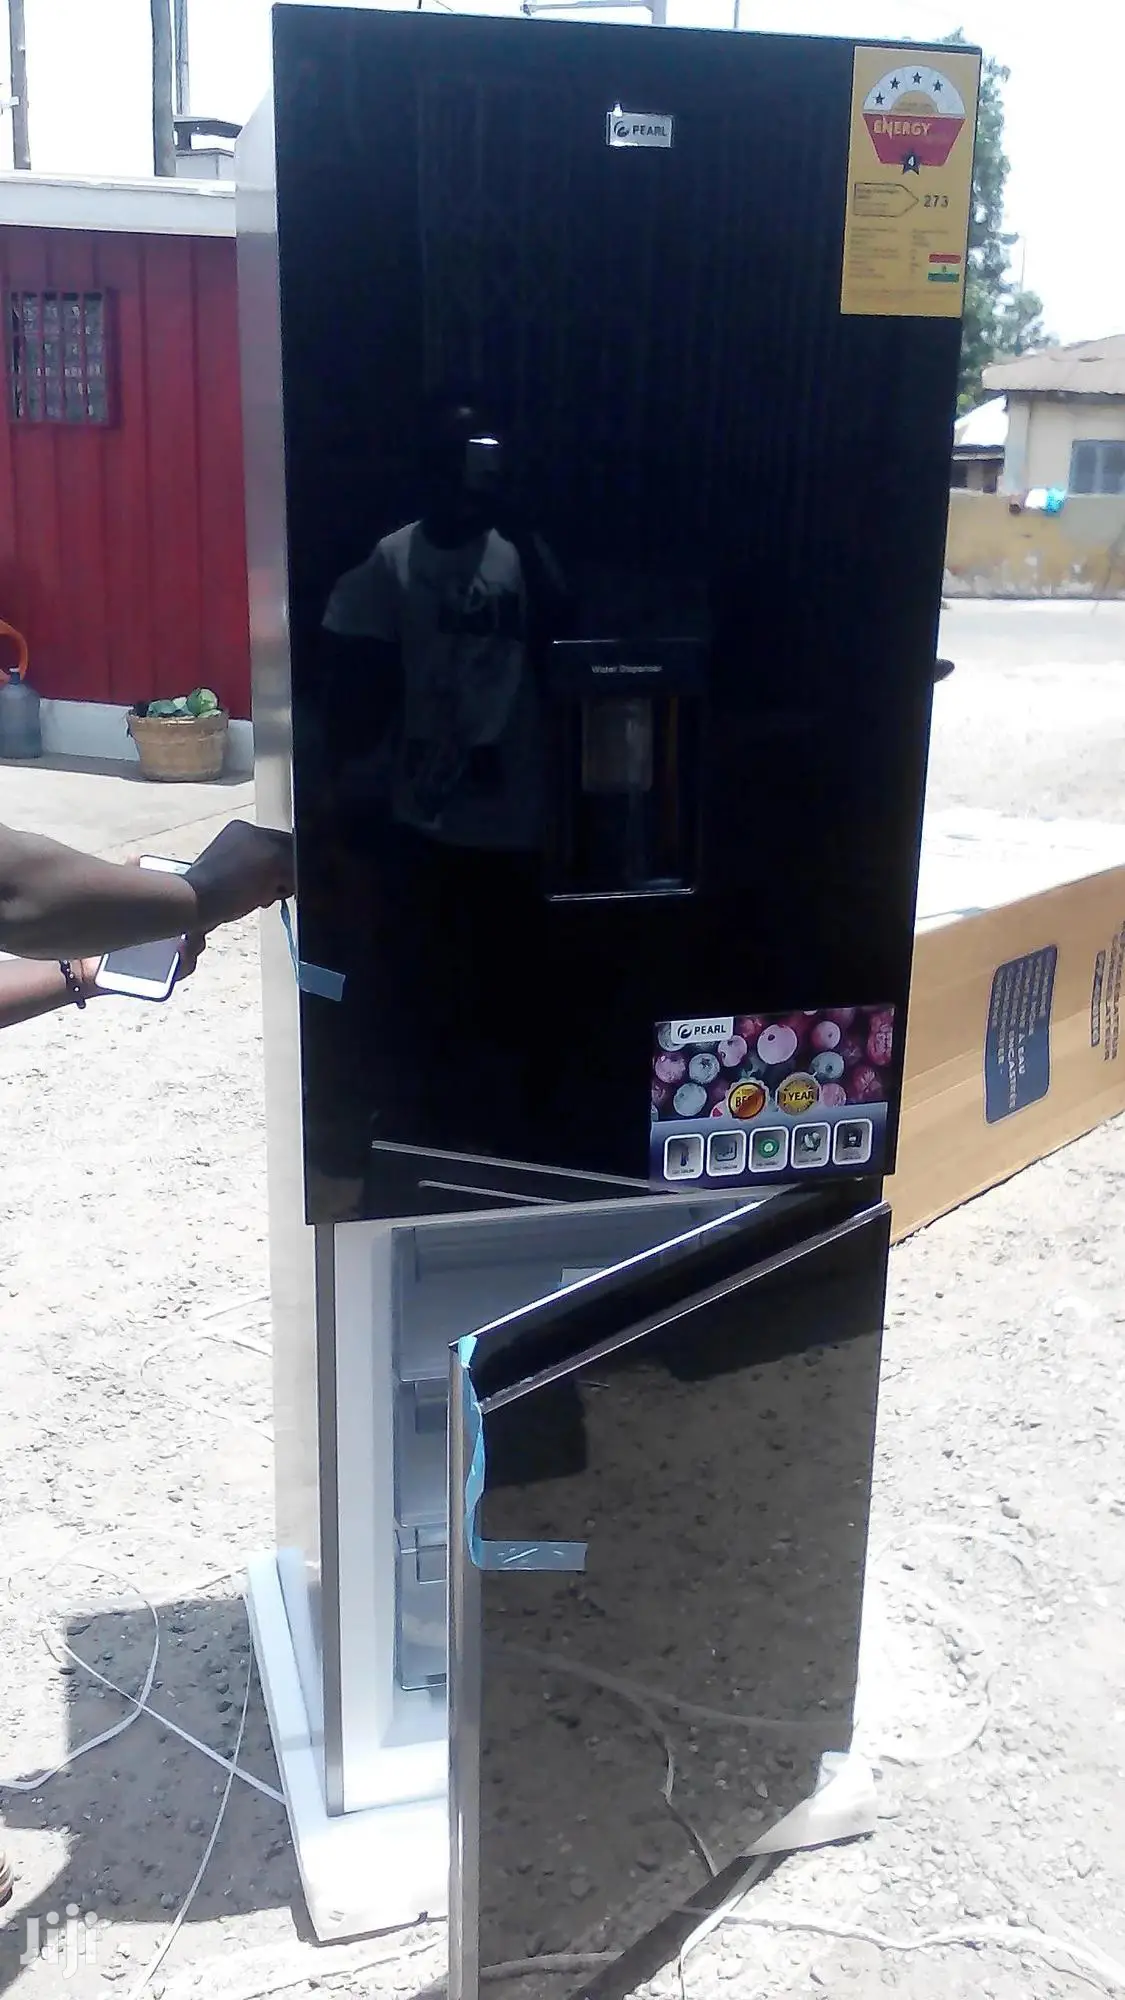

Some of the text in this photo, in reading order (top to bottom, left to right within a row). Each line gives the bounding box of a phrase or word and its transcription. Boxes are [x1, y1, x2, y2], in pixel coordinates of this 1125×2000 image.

[632, 125, 668, 137] PEARL
[873, 116, 932, 139] ENERGY
[907, 155, 915, 167] 4
[923, 194, 949, 208] 273
[591, 665, 618, 674] Water
[694, 1024, 727, 1036] PEARL
[788, 1090, 815, 1102] YEAR
